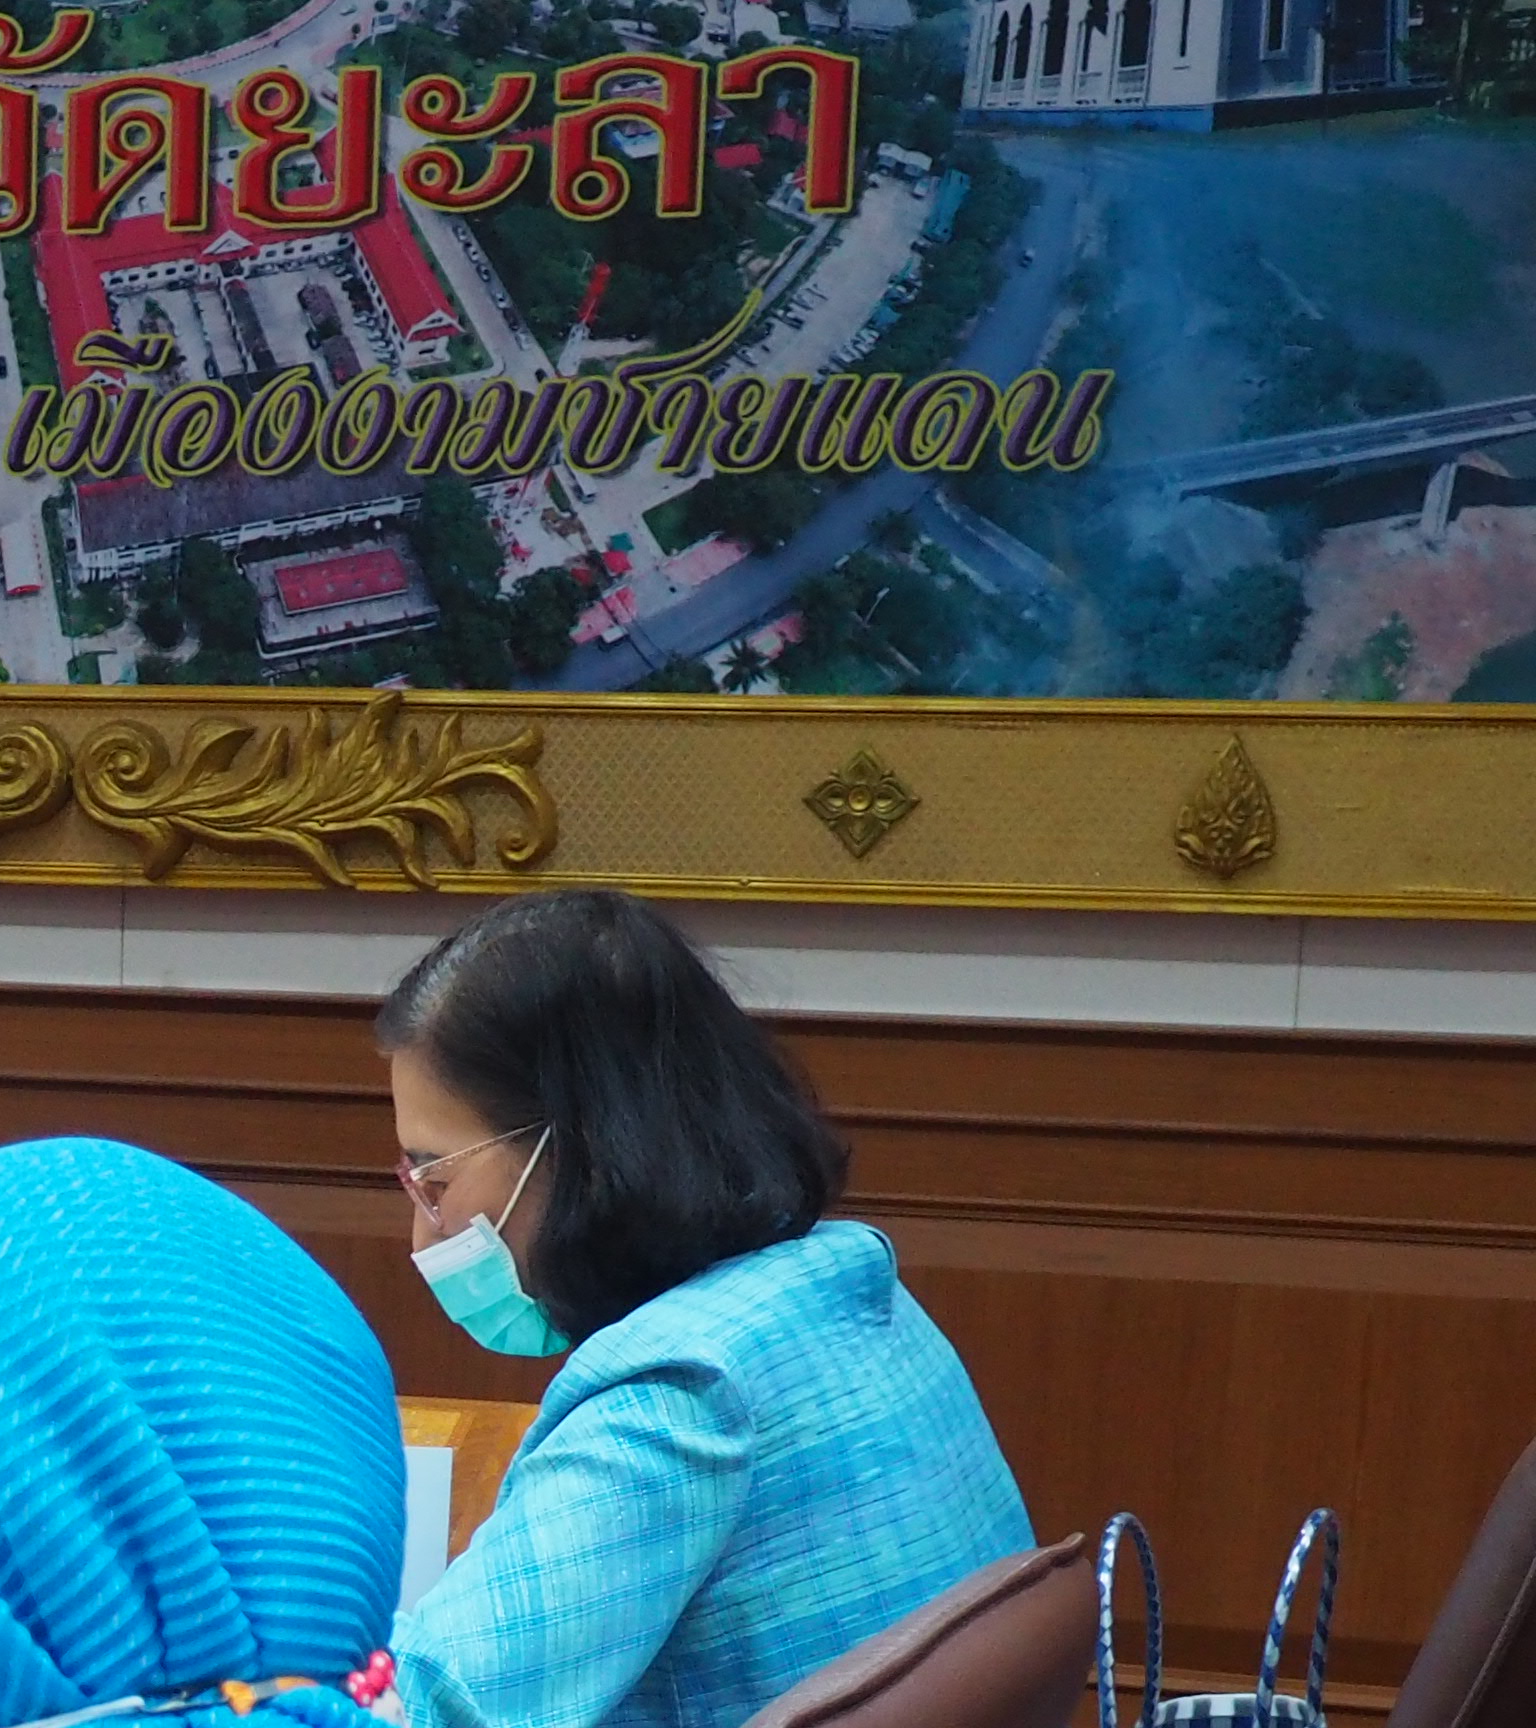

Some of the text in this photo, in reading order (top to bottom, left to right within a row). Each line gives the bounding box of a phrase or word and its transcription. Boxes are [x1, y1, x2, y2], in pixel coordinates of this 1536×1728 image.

[3, 287, 1116, 488] เมืองงามชายแดน
